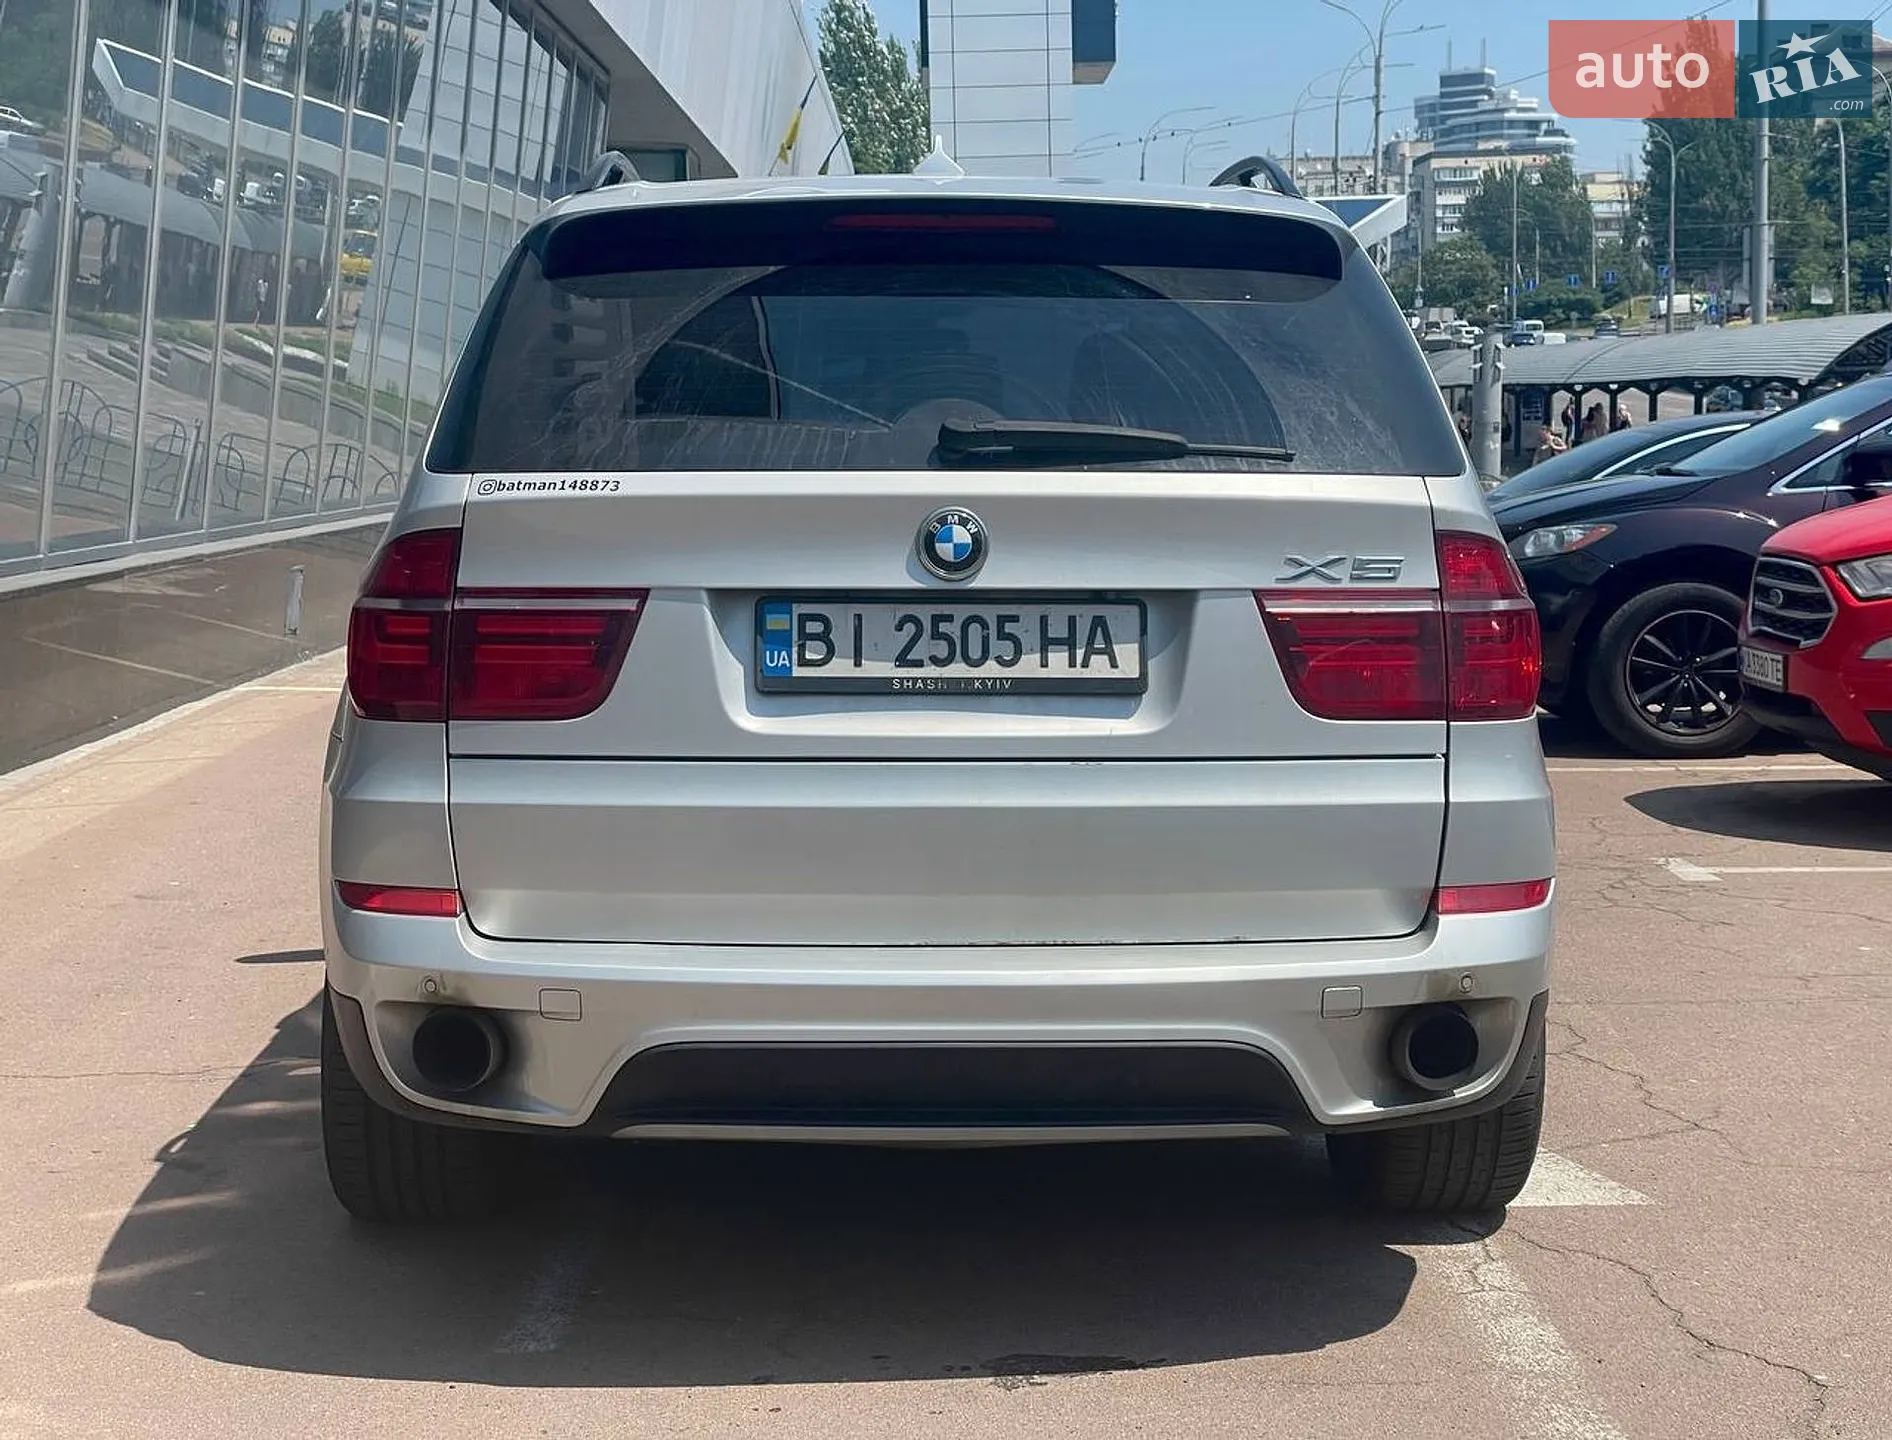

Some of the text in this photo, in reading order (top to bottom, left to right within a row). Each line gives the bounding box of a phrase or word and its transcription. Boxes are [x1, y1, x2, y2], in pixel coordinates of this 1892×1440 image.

[929, 514, 979, 534] BMW
[1274, 554, 1405, 583] X5
[894, 613, 1023, 669] 2505
[1039, 614, 1119, 669] HA
[766, 650, 790, 667] UA
